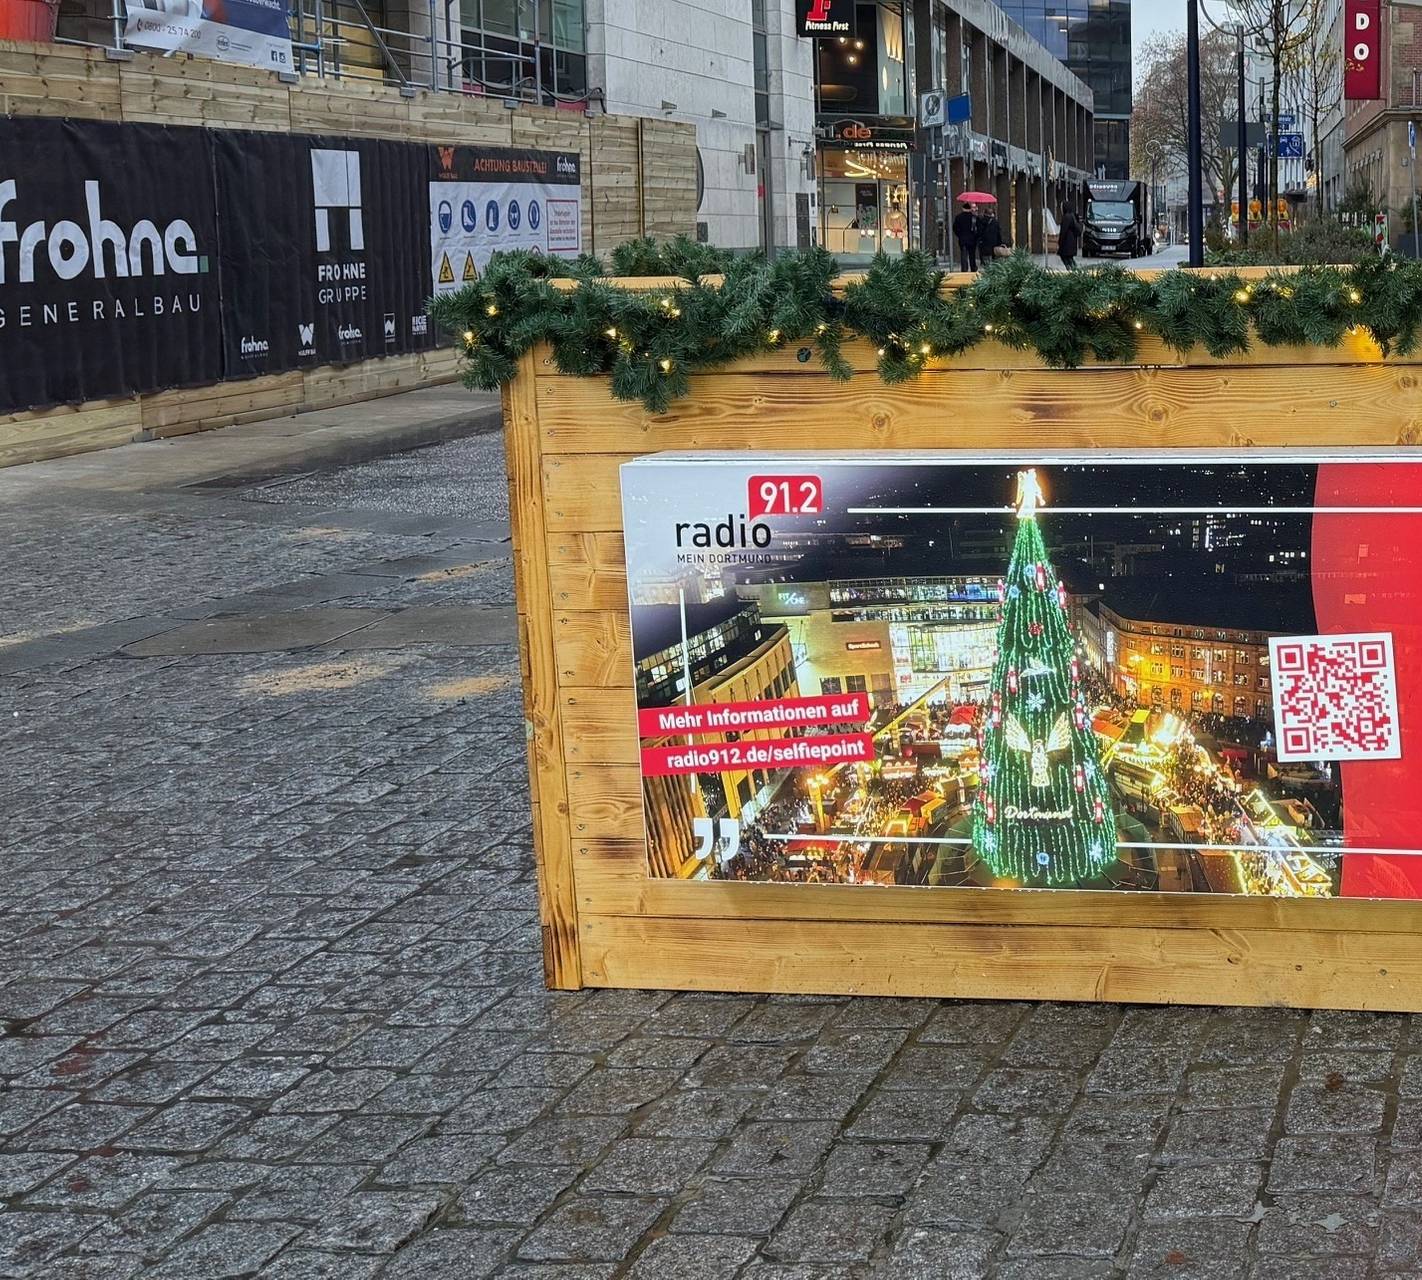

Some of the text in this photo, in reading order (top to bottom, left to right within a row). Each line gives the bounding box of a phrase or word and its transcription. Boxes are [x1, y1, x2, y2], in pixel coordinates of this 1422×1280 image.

[318, 263, 366, 282] FROHNE
[318, 285, 367, 304] GRUPPE
[760, 481, 818, 513] 91.2
[675, 514, 772, 549] radio
[677, 553, 772, 565] MEIN DORTMUND
[659, 700, 860, 730] Mehr Informationen auf
[667, 738, 865, 769] radio912.de/selfiepoint
